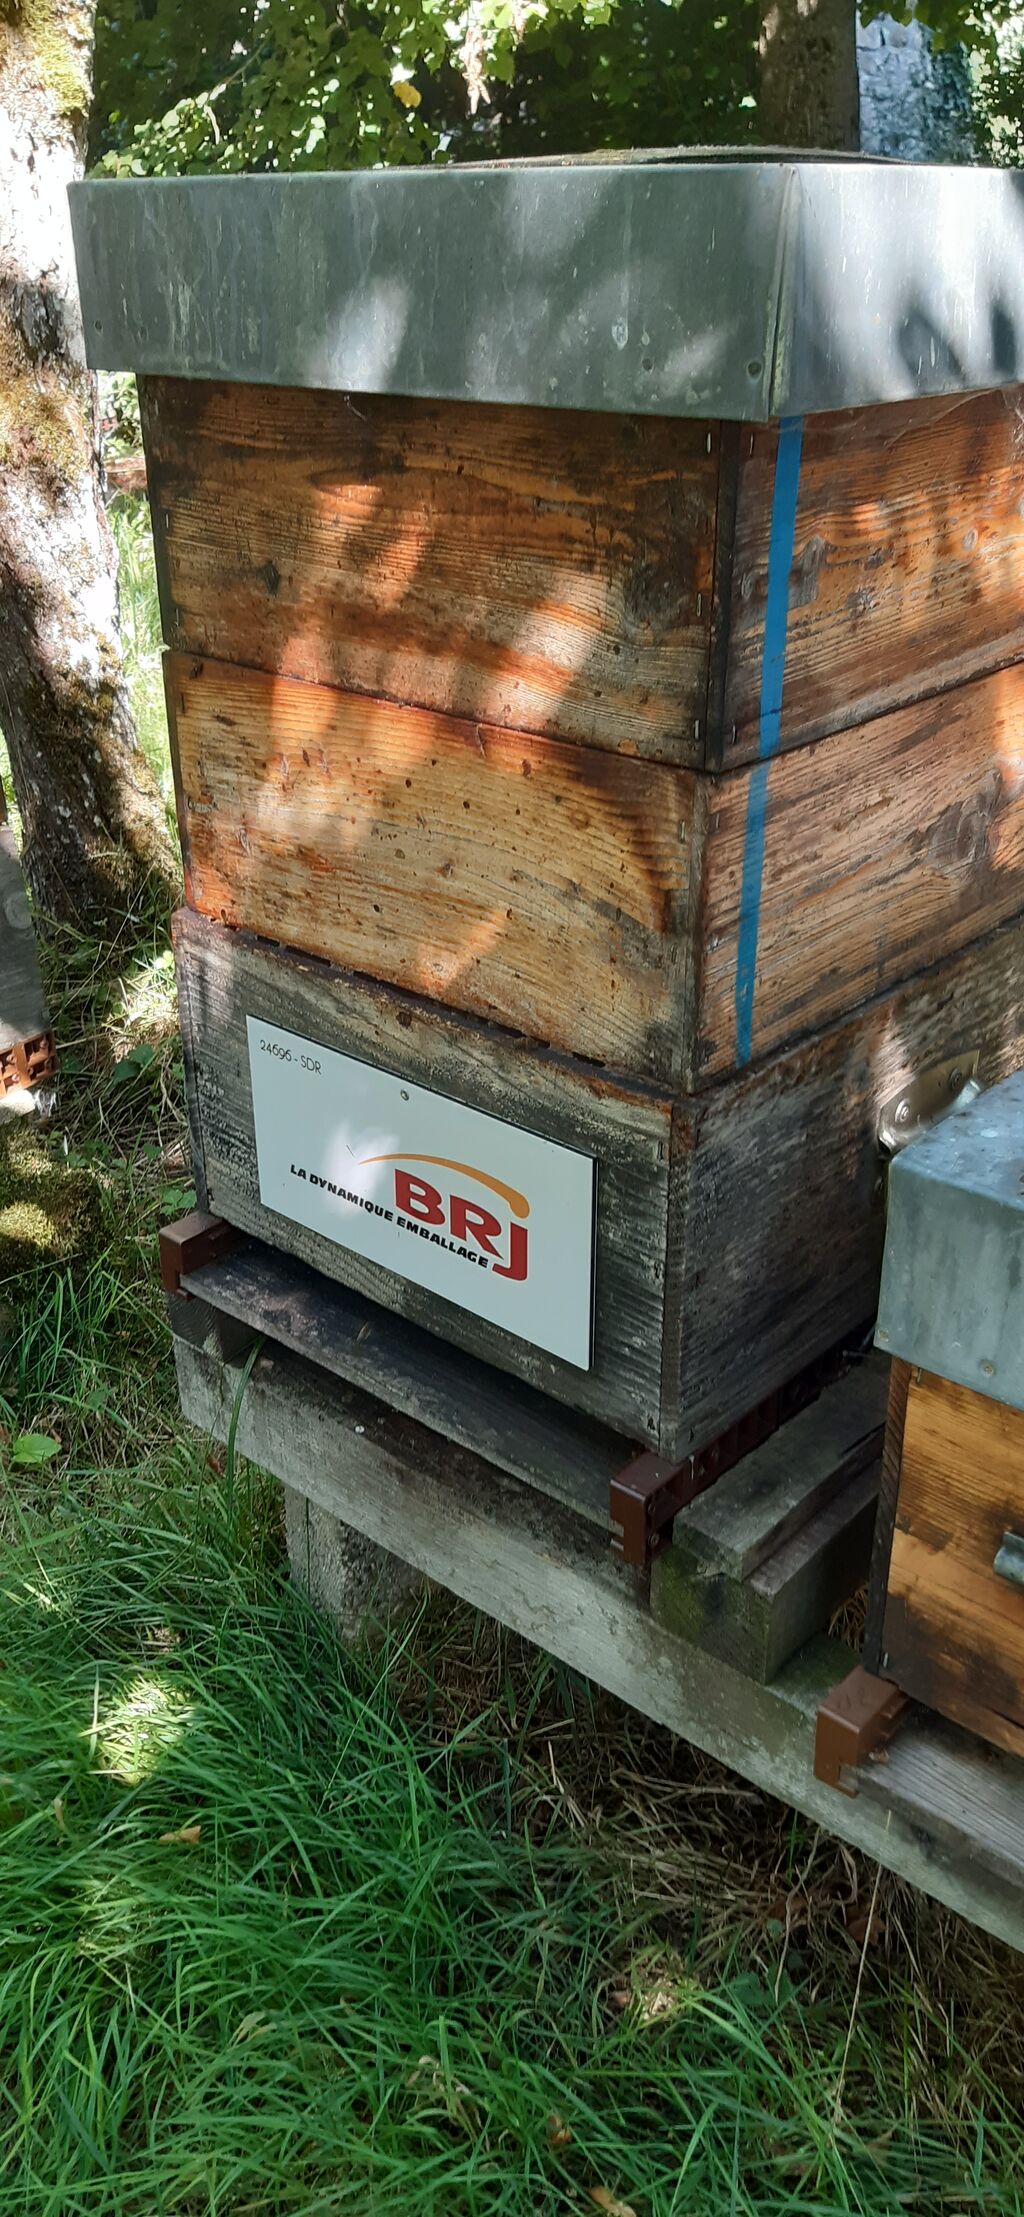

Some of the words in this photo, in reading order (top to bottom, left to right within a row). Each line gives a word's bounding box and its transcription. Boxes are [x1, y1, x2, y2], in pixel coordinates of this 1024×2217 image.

[259, 1039, 292, 1062] 24696
[300, 1055, 322, 1075] SDR
[290, 1164, 307, 1180] LA
[309, 1171, 394, 1222] DYNAMIQUE
[396, 1216, 489, 1269] EMBALLAGE
[394, 1168, 528, 1281] BRJ
